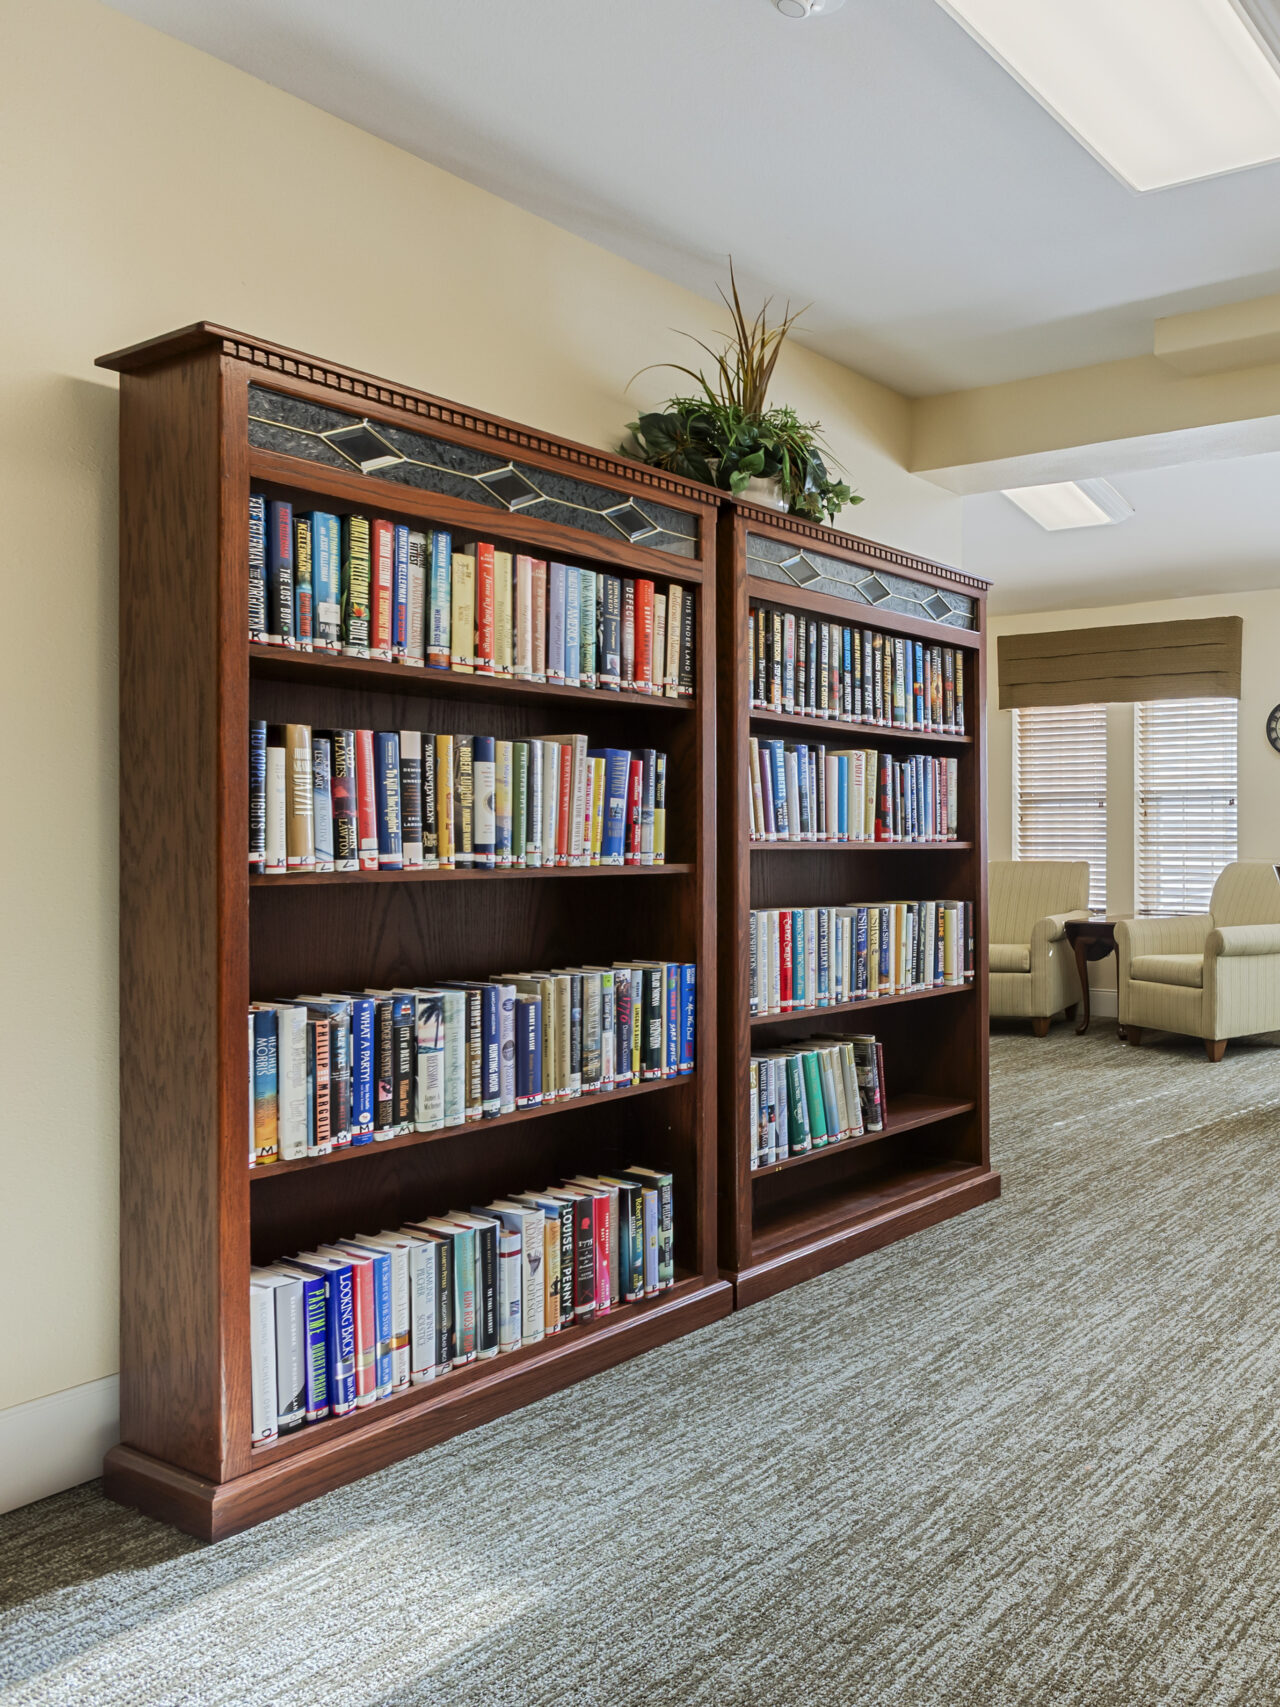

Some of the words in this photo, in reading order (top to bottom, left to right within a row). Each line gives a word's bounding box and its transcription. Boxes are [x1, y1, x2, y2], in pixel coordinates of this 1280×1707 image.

[249, 519, 264, 568] KELLERMAN
[297, 523, 308, 572] KELLERMAN
[350, 517, 369, 558] JONATHAN
[399, 528, 408, 563] JONATHAN
[437, 533, 447, 567] JONATHAN
[409, 542, 418, 566] FITTEST
[280, 568, 291, 584] THE
[350, 557, 369, 605] KELLERMAN
[398, 563, 408, 603] KELLERMAN
[249, 578, 265, 631] FORGOTTEN
[280, 584, 291, 604] LOST
[280, 605, 291, 626] BOY
[567, 607, 578, 647] AMERICA
[625, 587, 634, 639] DEFECTORS
[350, 620, 369, 647] GUILT
[684, 649, 692, 672] LAND
[251, 728, 266, 746] TED
[251, 749, 266, 788] KOPPEL
[335, 736, 346, 778] FLAMES
[460, 747, 472, 774] ROBERT
[776, 749, 785, 765] NORA
[461, 776, 472, 807] LUDLUM
[611, 756, 627, 796] ANNAPOLIS
[777, 767, 786, 797] ROBERTS
[251, 793, 266, 830] LIGHTS
[338, 817, 348, 857] LAWTON
[857, 915, 867, 943] Silva
[870, 917, 879, 947] Silva
[361, 1011, 371, 1036] WHAT
[382, 1006, 392, 1020] THE
[470, 996, 481, 1027] THOMAS
[617, 996, 632, 1025] 1776
[361, 1040, 370, 1049] A
[382, 1021, 392, 1039] EDGE
[400, 1027, 410, 1041] CITY
[470, 1028, 481, 1056] HARRIS
[256, 1037, 269, 1076] MORRIS
[317, 1024, 328, 1068] PHILLIP
[489, 1043, 499, 1071] HUNTING
[360, 1050, 372, 1082] PARTY!
[380, 1050, 391, 1078] JUSTICE
[489, 1072, 498, 1092] HOUR
[316, 1083, 330, 1142] MARGOLIN
[562, 1208, 573, 1252] LOUISE
[340, 1272, 352, 1324] LOOKING
[416, 1268, 426, 1299] PILCHER
[563, 1267, 573, 1307] PENNY
[308, 1289, 325, 1335] PASTIME
[464, 1291, 473, 1309] RUN
[527, 1277, 536, 1323] POPESCU
[416, 1313, 426, 1348] SOLSTICE
[426, 1313, 434, 1344] WINTER
[464, 1310, 473, 1332] ROSE
[342, 1325, 354, 1355] BACK
[464, 1333, 473, 1353] RUN
